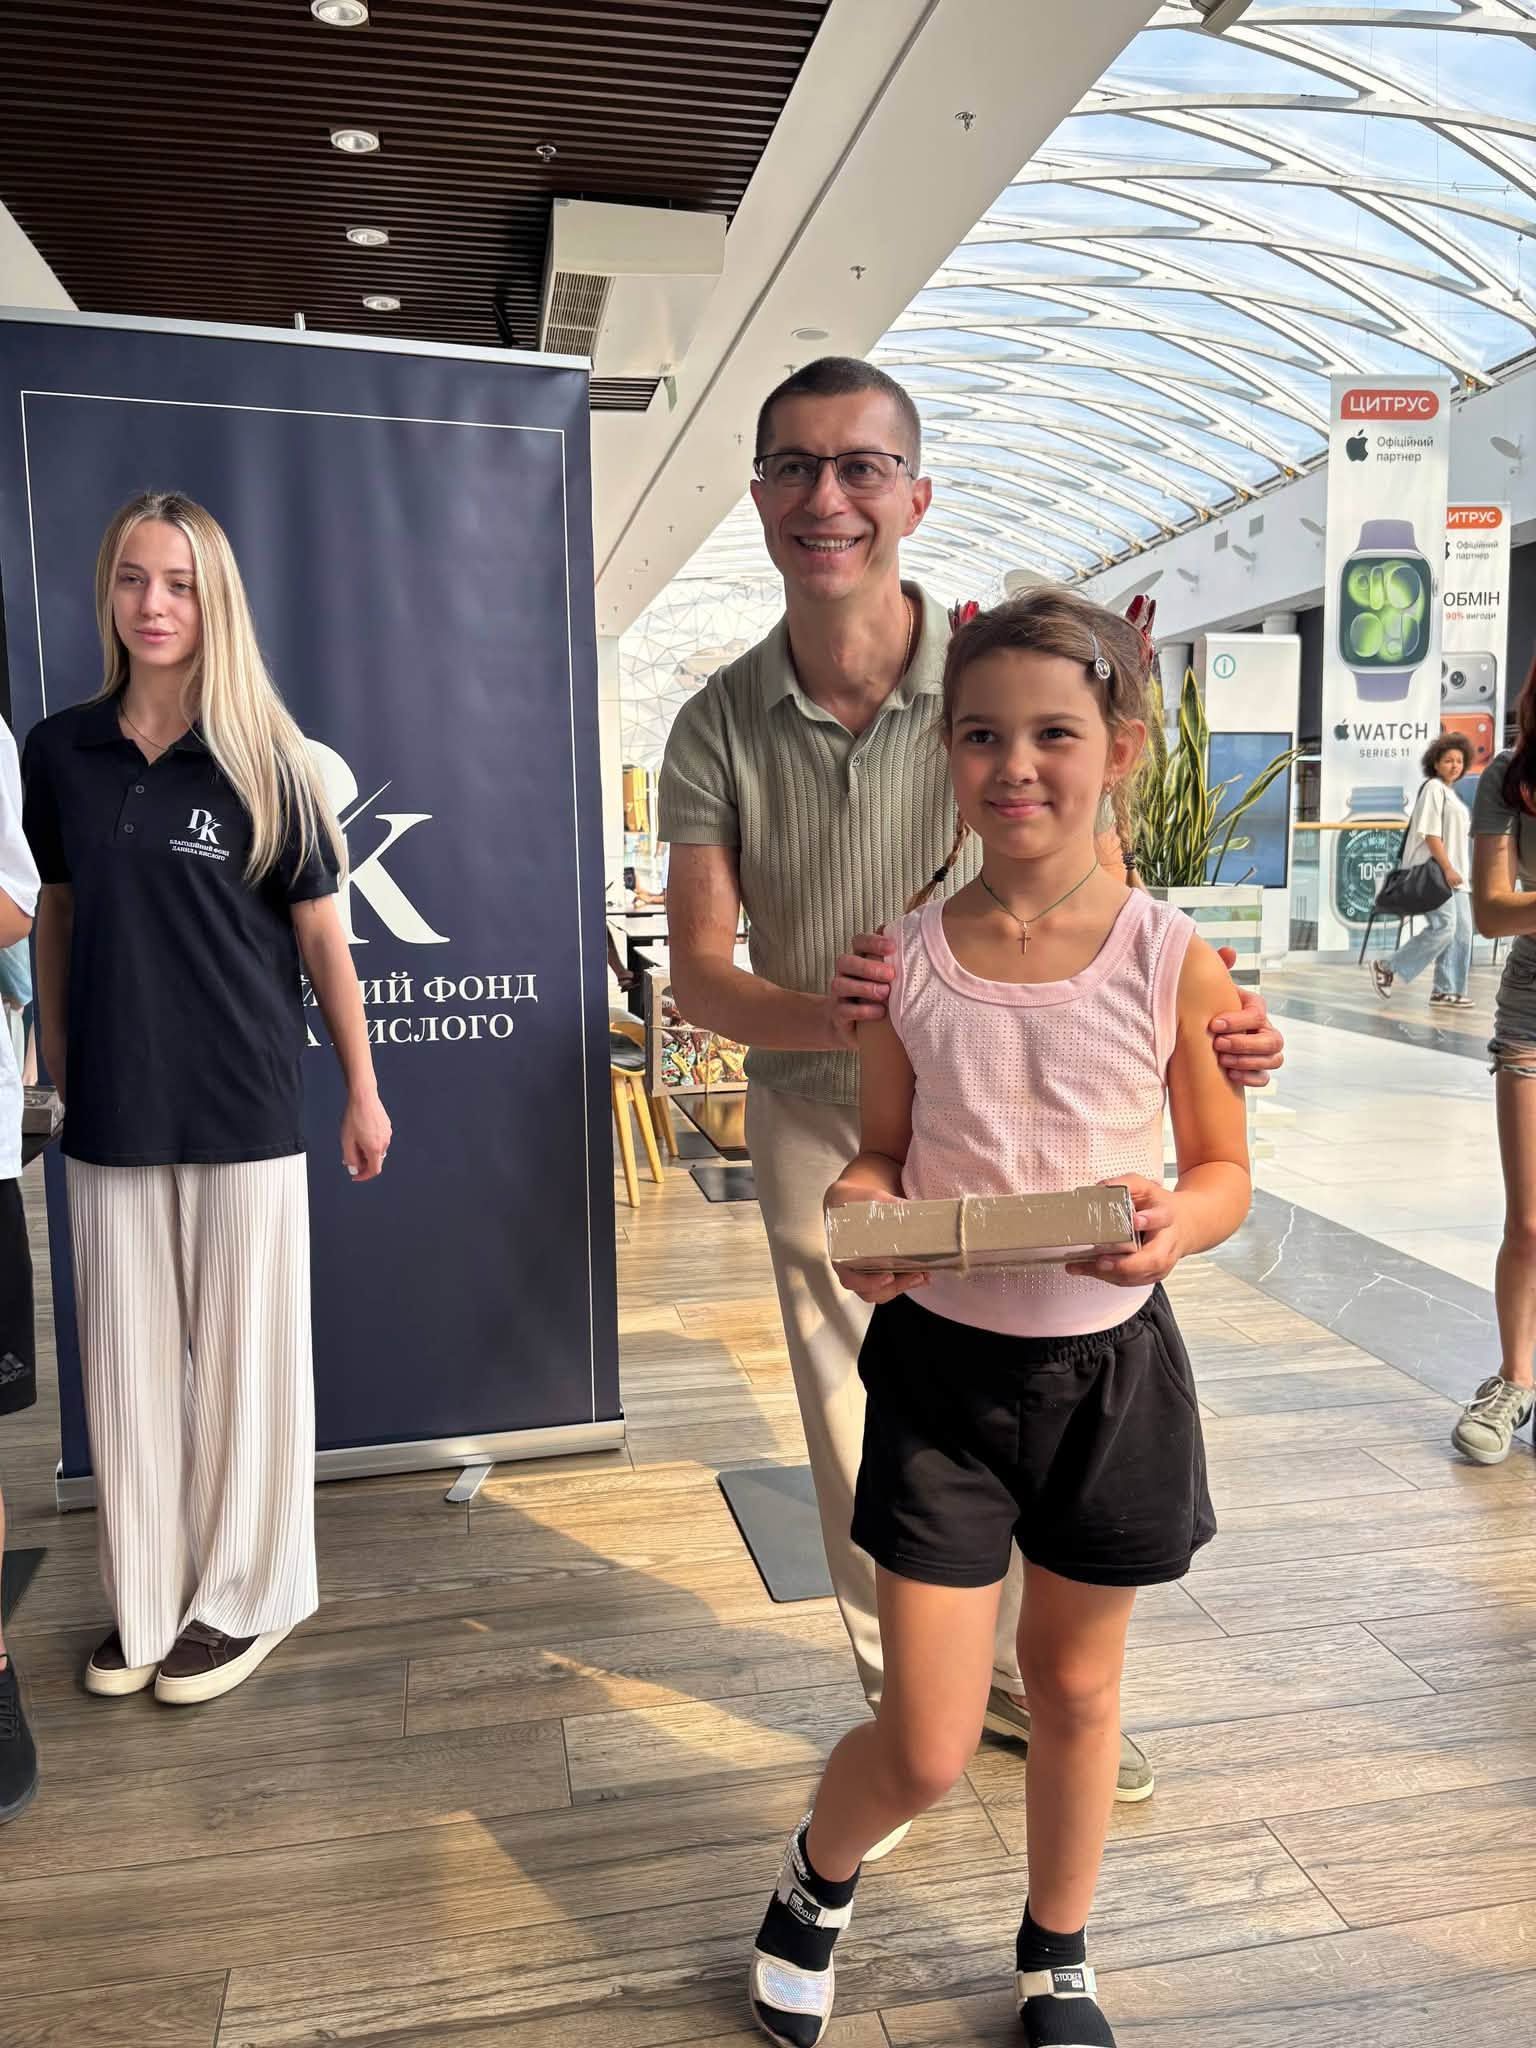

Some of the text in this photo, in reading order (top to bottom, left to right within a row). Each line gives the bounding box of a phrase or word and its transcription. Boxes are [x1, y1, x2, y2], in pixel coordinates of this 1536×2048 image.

[1350, 396, 1431, 413] ЦИТРУС
[1376, 435, 1434, 449] Офіційний
[1376, 453, 1422, 463] партнер
[1447, 511, 1497, 524] ИТРУС
[1443, 591, 1500, 607] ОБМІН
[1353, 722, 1428, 741] WATCH
[1359, 747, 1410, 758] SERIES 11
[423, 974, 539, 1005] ФОНД
[330, 1013, 514, 1047] ИСЛОГО
